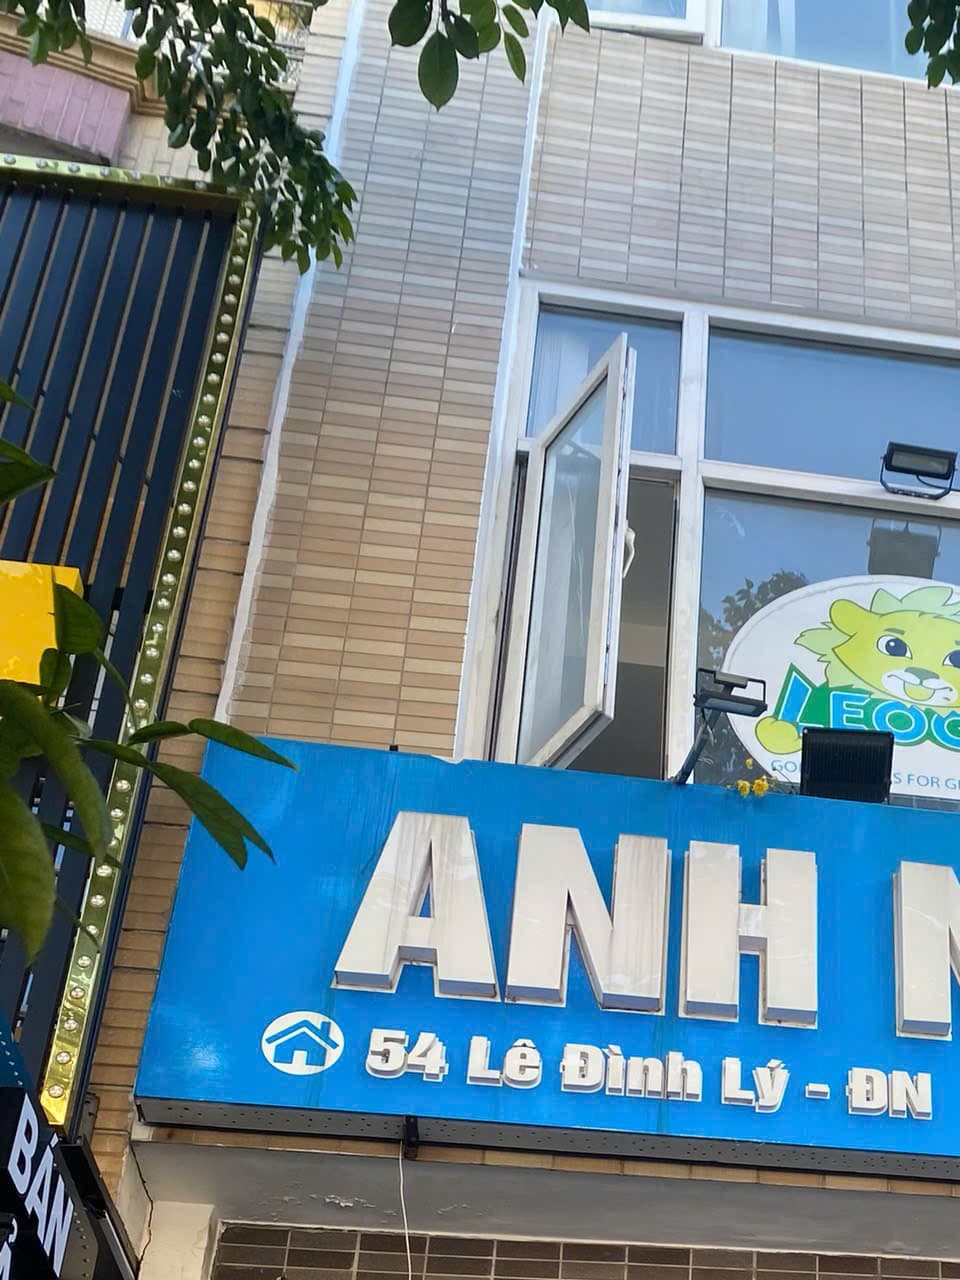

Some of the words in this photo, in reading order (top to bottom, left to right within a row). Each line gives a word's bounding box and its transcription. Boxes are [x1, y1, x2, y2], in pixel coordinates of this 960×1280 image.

[907, 774, 941, 789] FOR
[331, 811, 819, 1030] ANH
[366, 1028, 449, 1082] 54
[466, 1035, 543, 1089] Lê
[559, 1042, 703, 1102] Đình
[721, 1056, 790, 1113] Lý
[845, 1066, 933, 1120] ĐN
[8, 1093, 74, 1279] BÁN
